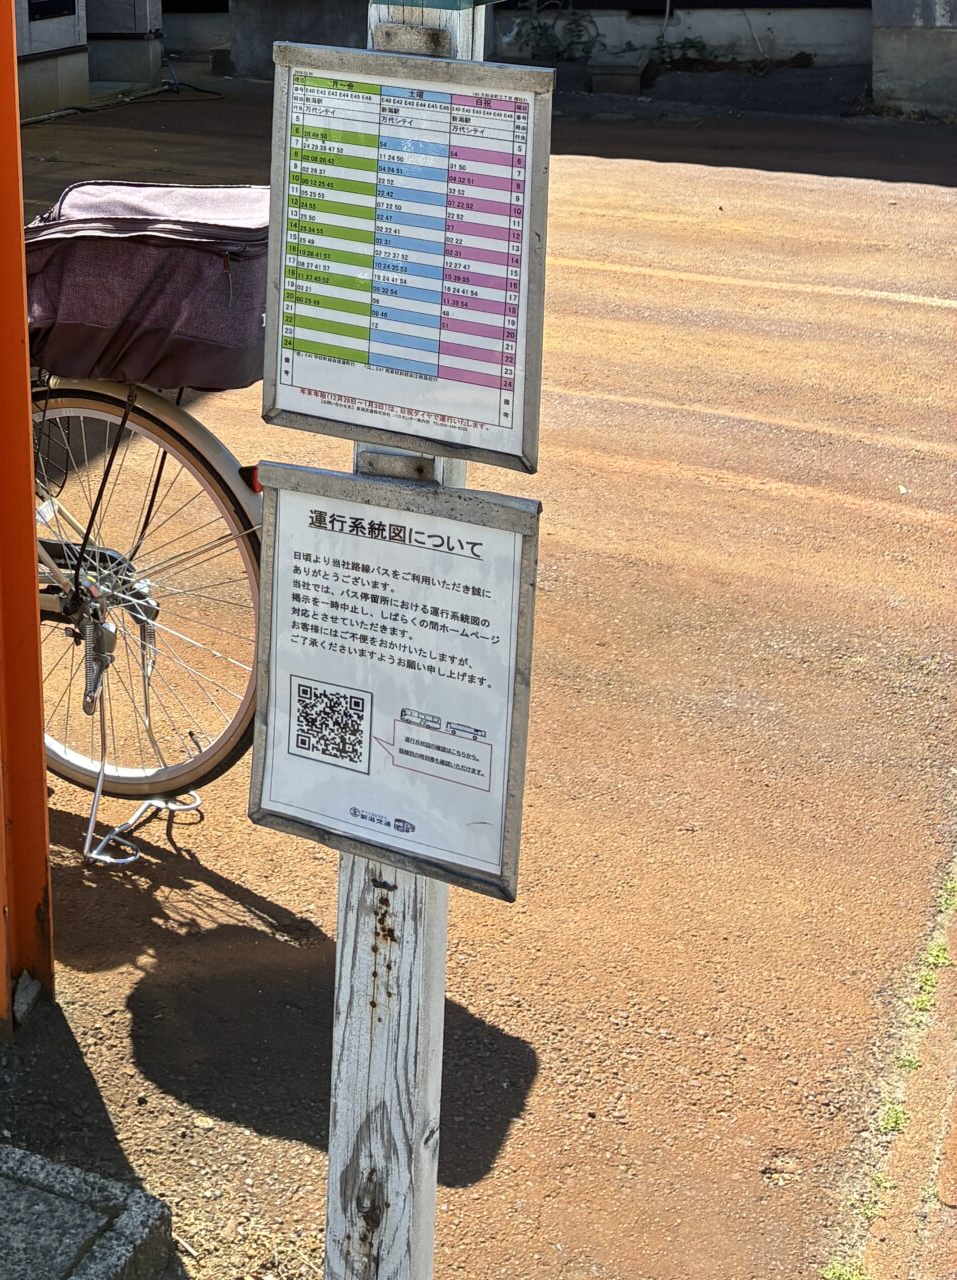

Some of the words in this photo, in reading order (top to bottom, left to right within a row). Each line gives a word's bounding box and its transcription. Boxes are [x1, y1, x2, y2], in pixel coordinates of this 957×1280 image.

[475, 98, 491, 107] 日祝
[308, 509, 484, 559] 運行系統図について
